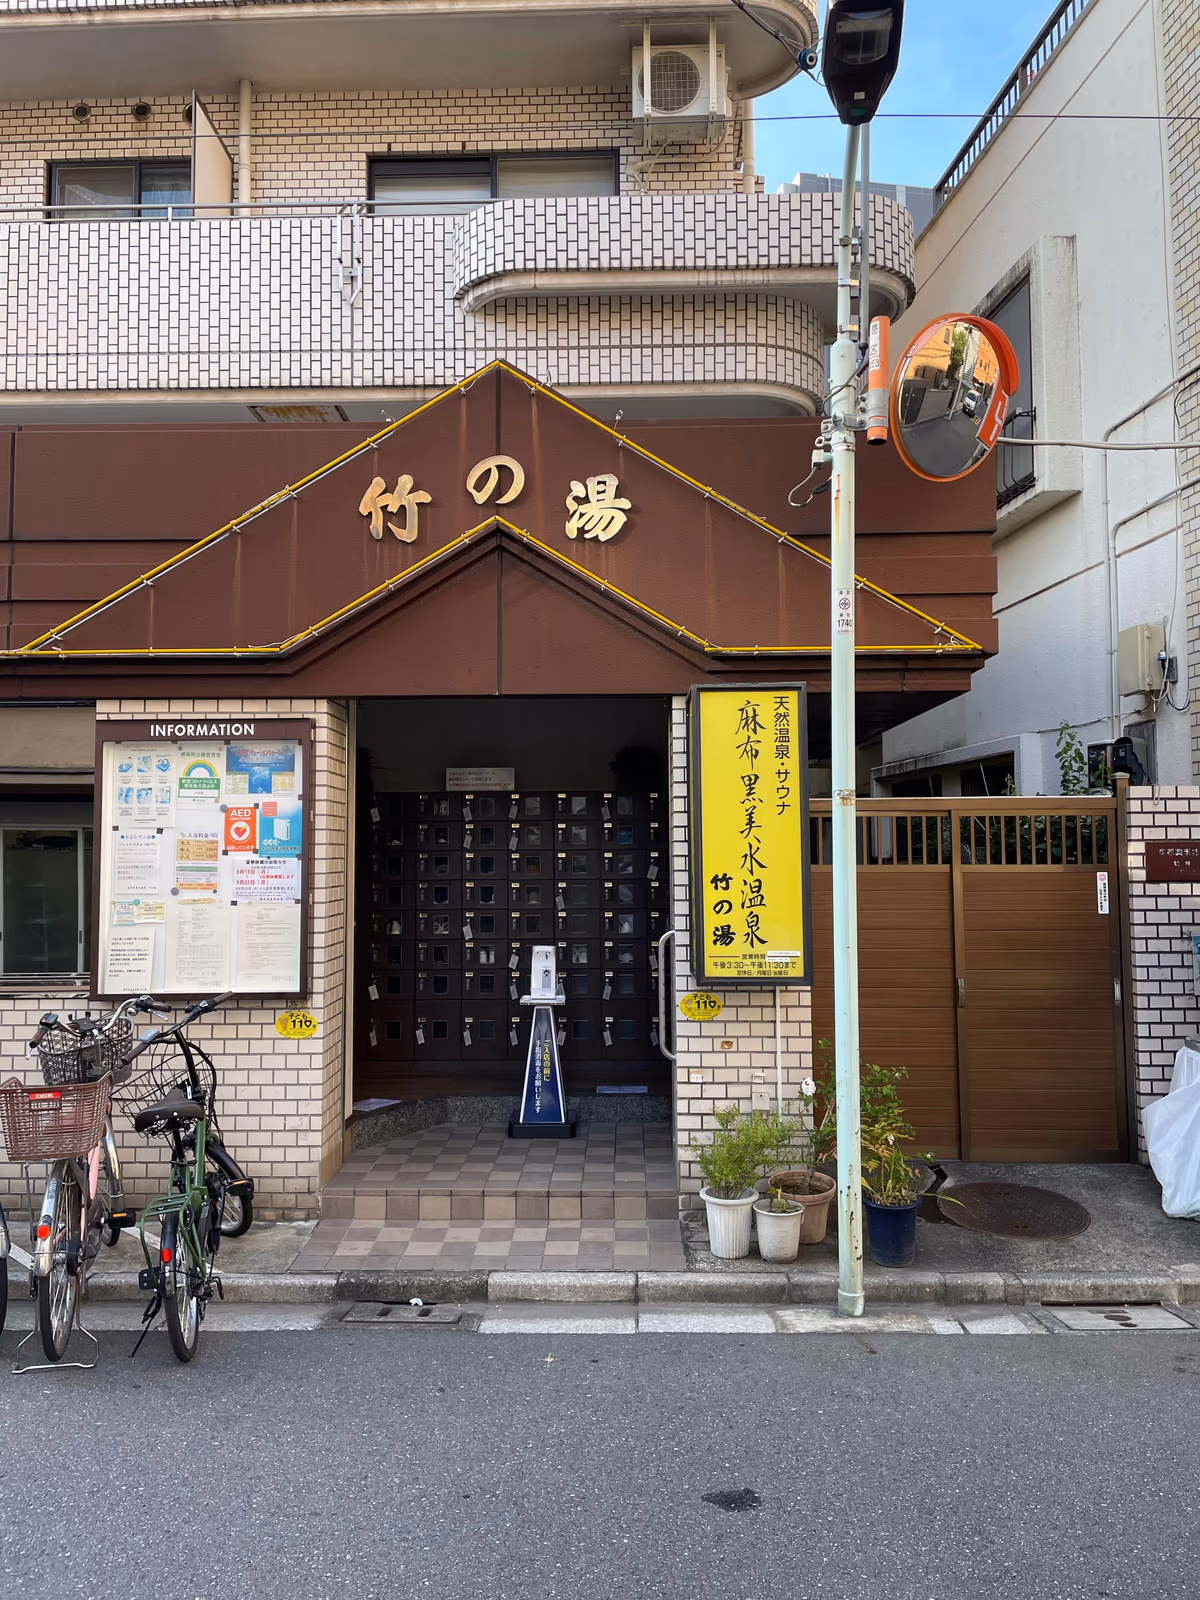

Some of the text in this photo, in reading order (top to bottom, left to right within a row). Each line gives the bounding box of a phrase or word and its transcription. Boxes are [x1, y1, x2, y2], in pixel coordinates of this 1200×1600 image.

[359, 454, 632, 543] 竹の湯
[837, 619, 853, 628] 1740
[150, 723, 255, 737] INFORMATION
[773, 695, 792, 816] 天然温泉・サウナ
[230, 809, 251, 817] AED
[734, 698, 769, 949] 麻布黒美水温泉
[710, 872, 737, 947] 竹の湯
[288, 1012, 308, 1020] 子ども
[534, 1039, 542, 1114] 手指消毒をお願いします
[543, 1039, 551, 1082] ご入店の前に
